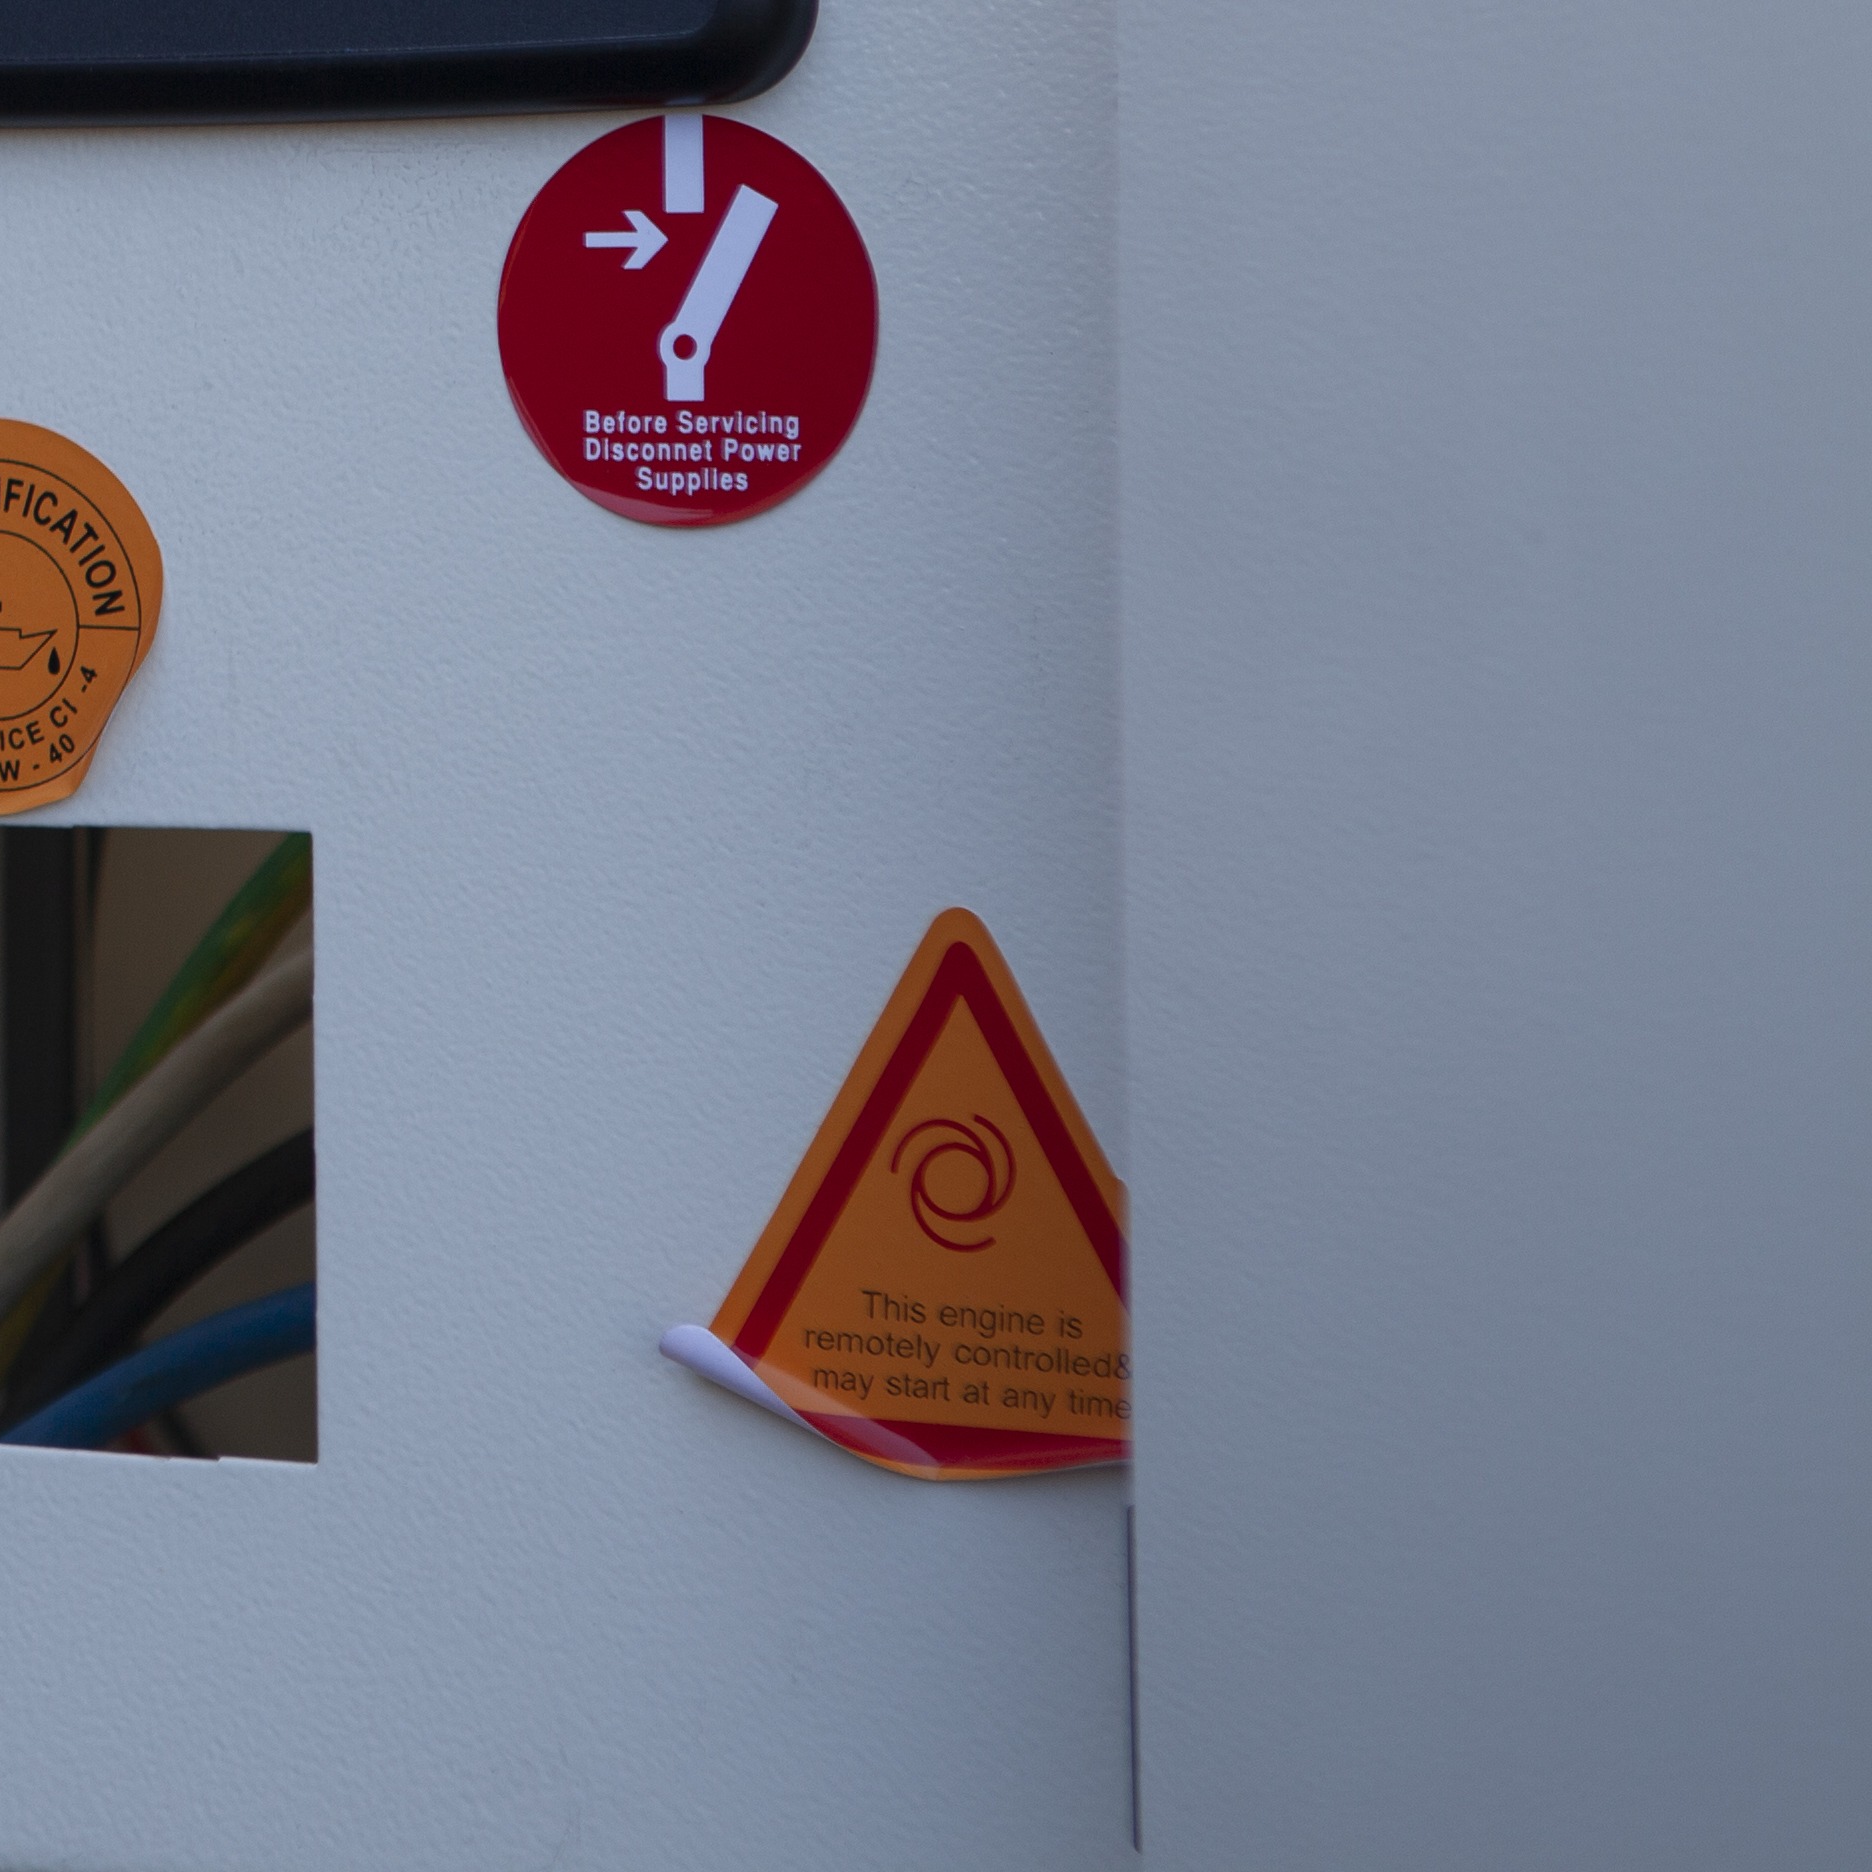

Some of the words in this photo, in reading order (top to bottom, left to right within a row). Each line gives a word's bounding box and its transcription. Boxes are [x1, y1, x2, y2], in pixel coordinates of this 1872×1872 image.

[584, 410, 667, 435] Before
[675, 410, 800, 439] Servicing
[584, 438, 713, 462] Disconnet
[722, 439, 802, 462] Power
[636, 467, 748, 495] Supplies
[49, 734, 75, 764] 40
[862, 1290, 926, 1323] This
[940, 1302, 1045, 1339] engine
[1059, 1310, 1083, 1339] is
[804, 1329, 940, 1366] remotely
[813, 1366, 874, 1399] may
[886, 1373, 950, 1403] start
[963, 1380, 989, 1406] at
[1003, 1388, 1055, 1419] any
